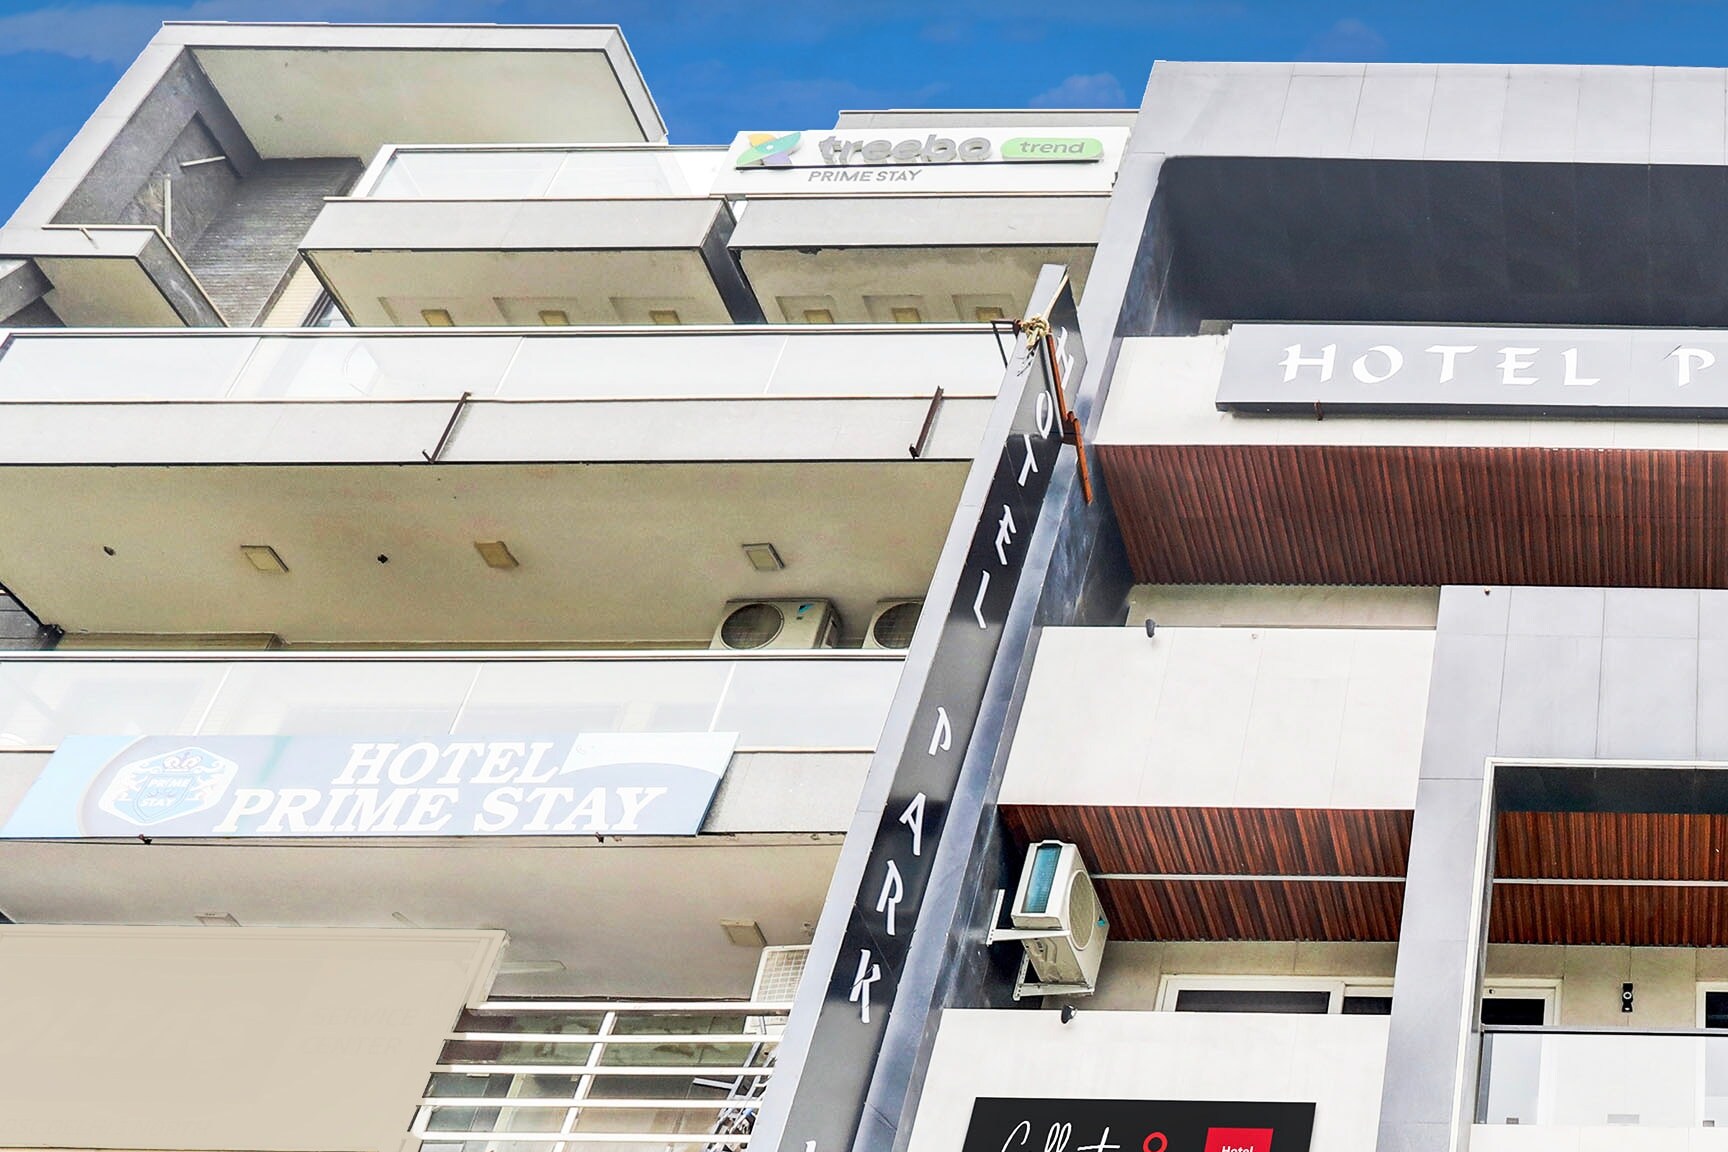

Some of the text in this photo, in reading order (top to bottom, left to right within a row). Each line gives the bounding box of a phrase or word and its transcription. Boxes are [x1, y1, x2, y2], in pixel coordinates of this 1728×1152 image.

[818, 134, 1085, 163] treebo trend
[808, 169, 922, 182] PRIME STAY
[1278, 344, 1600, 386] HOTEL
[973, 327, 1074, 629] HOTEL
[331, 742, 564, 785] HOTEL
[212, 786, 667, 833] PRIME STAY
[849, 707, 952, 1024] PARK
